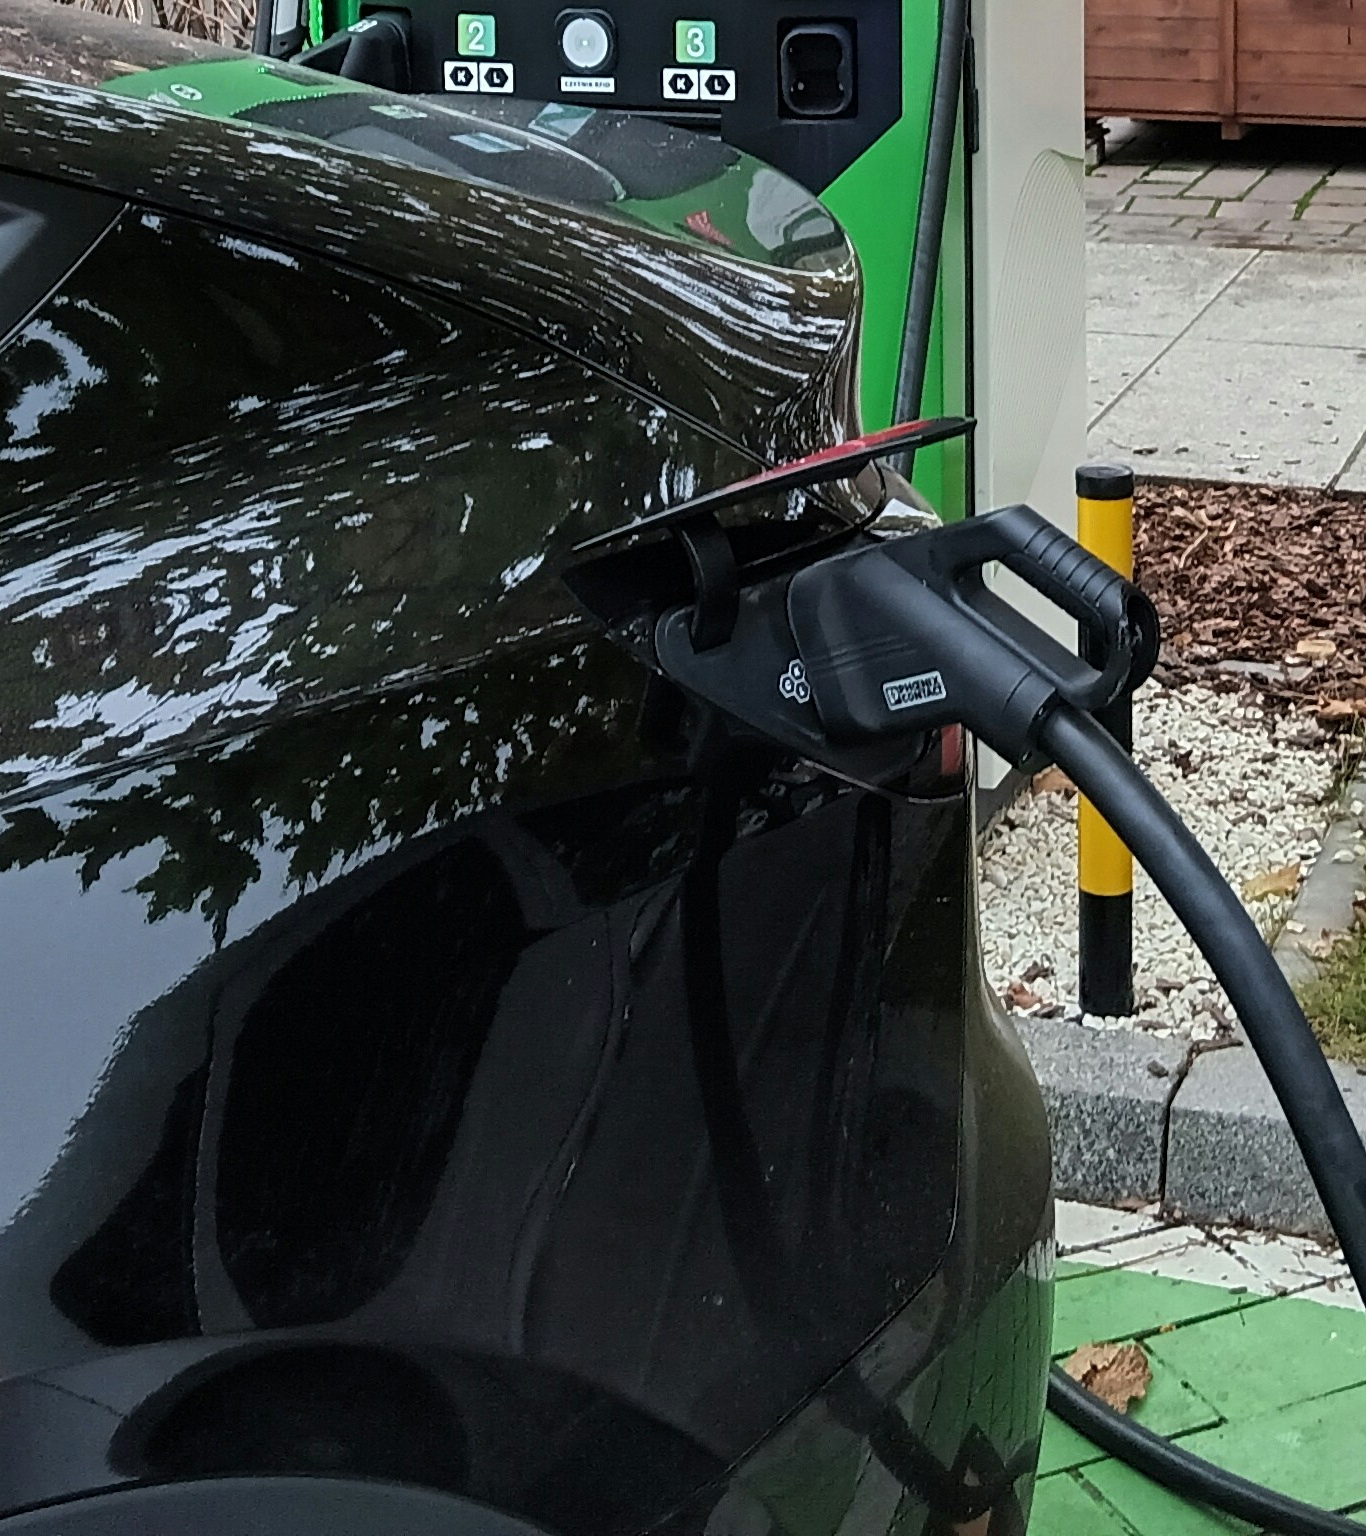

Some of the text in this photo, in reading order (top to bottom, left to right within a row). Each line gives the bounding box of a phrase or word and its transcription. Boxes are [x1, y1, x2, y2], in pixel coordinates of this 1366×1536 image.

[468, 21, 485, 51] 2
[686, 27, 705, 57] 3
[457, 70, 466, 82] K
[493, 72, 501, 83] L
[677, 78, 686, 90] K
[713, 78, 722, 90] L
